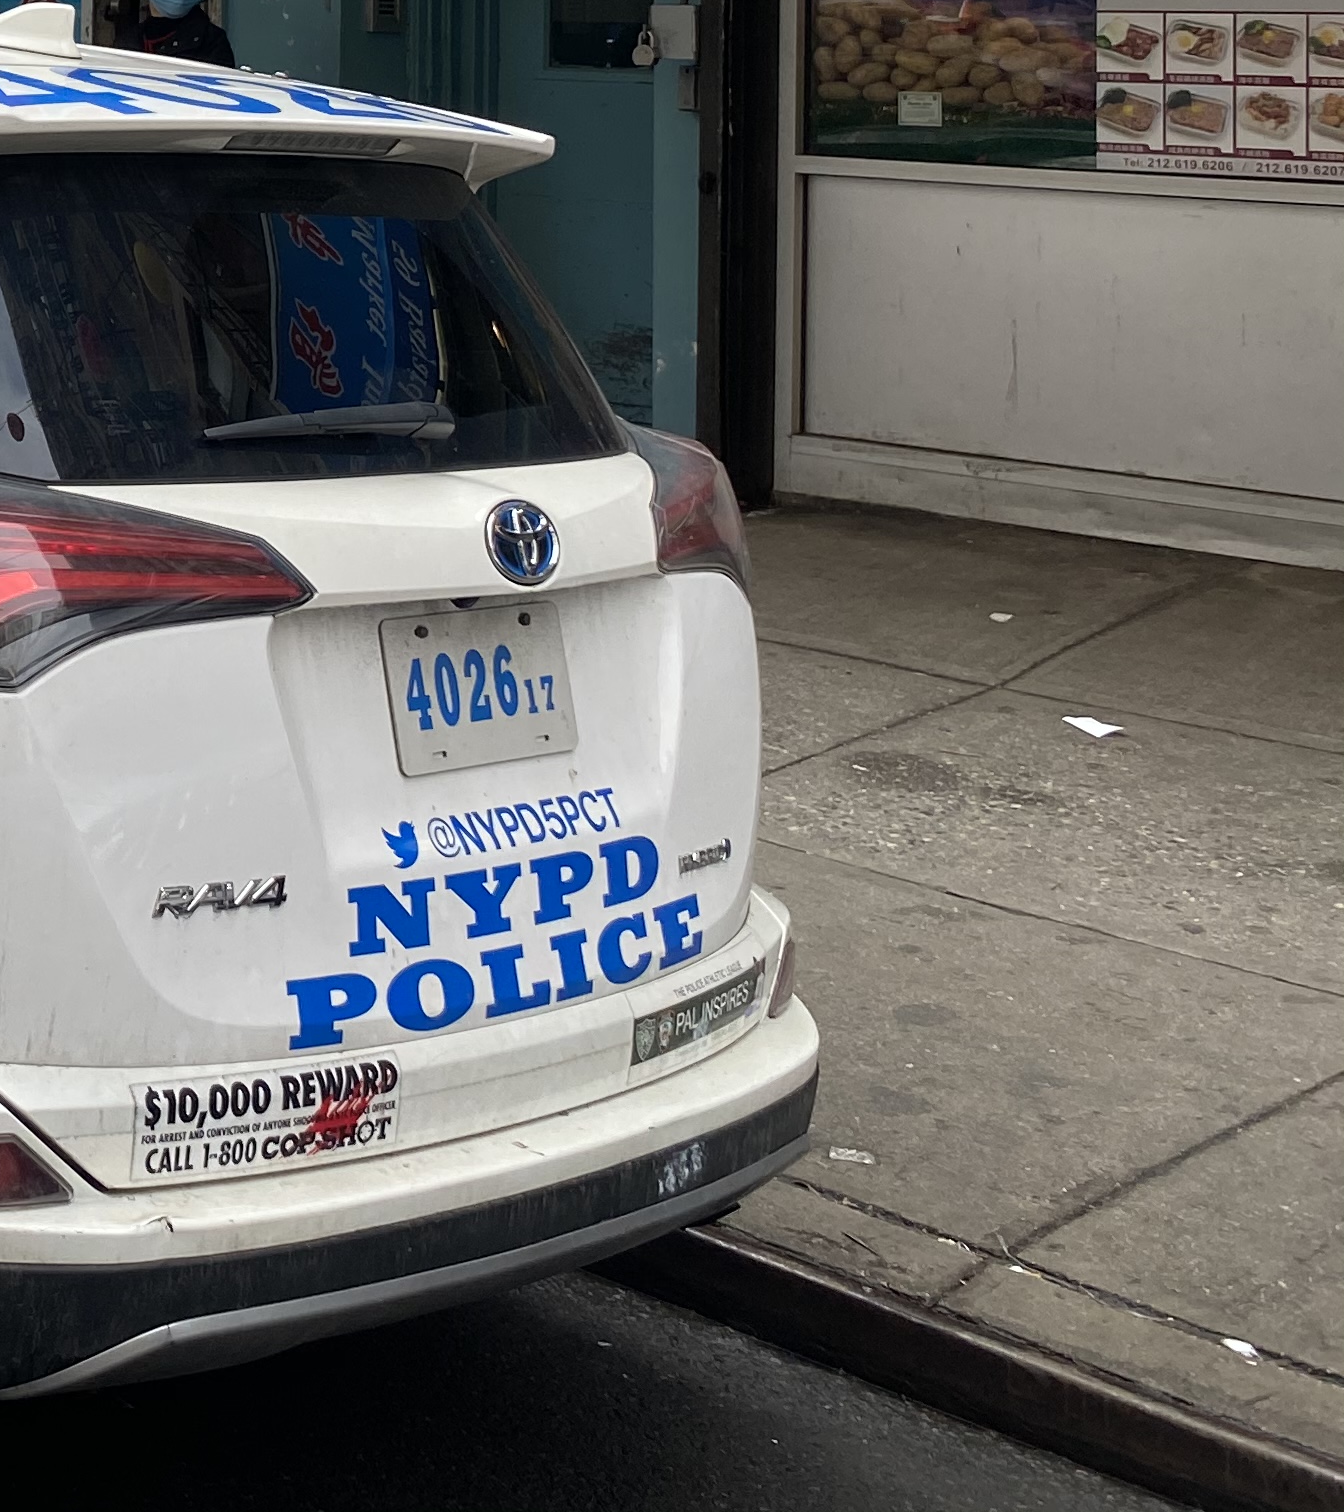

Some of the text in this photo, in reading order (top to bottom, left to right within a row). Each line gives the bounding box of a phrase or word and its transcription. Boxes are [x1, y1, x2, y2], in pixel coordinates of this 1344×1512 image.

[1147, 157, 1234, 174] 212.619.6206
[406, 645, 555, 732] 4026 17
[428, 788, 622, 859] @NYPD5PCT
[152, 874, 288, 921] RAV4
[348, 835, 659, 957] NYPD
[286, 894, 703, 1050] POLICE
[675, 980, 749, 1037] PAL INSPIRES
[144, 1078, 272, 1131] $10,000
[281, 1059, 398, 1112] REWARD
[141, 1133, 157, 1145] FOR
[158, 1129, 187, 1144] ARREST
[188, 1127, 205, 1141] AND
[206, 1122, 251, 1140] CONVICTION
[252, 1121, 262, 1132] OF
[263, 1117, 291, 1131] ANYONE
[145, 1145, 193, 1174] CALL
[202, 1137, 257, 1169] 1-800
